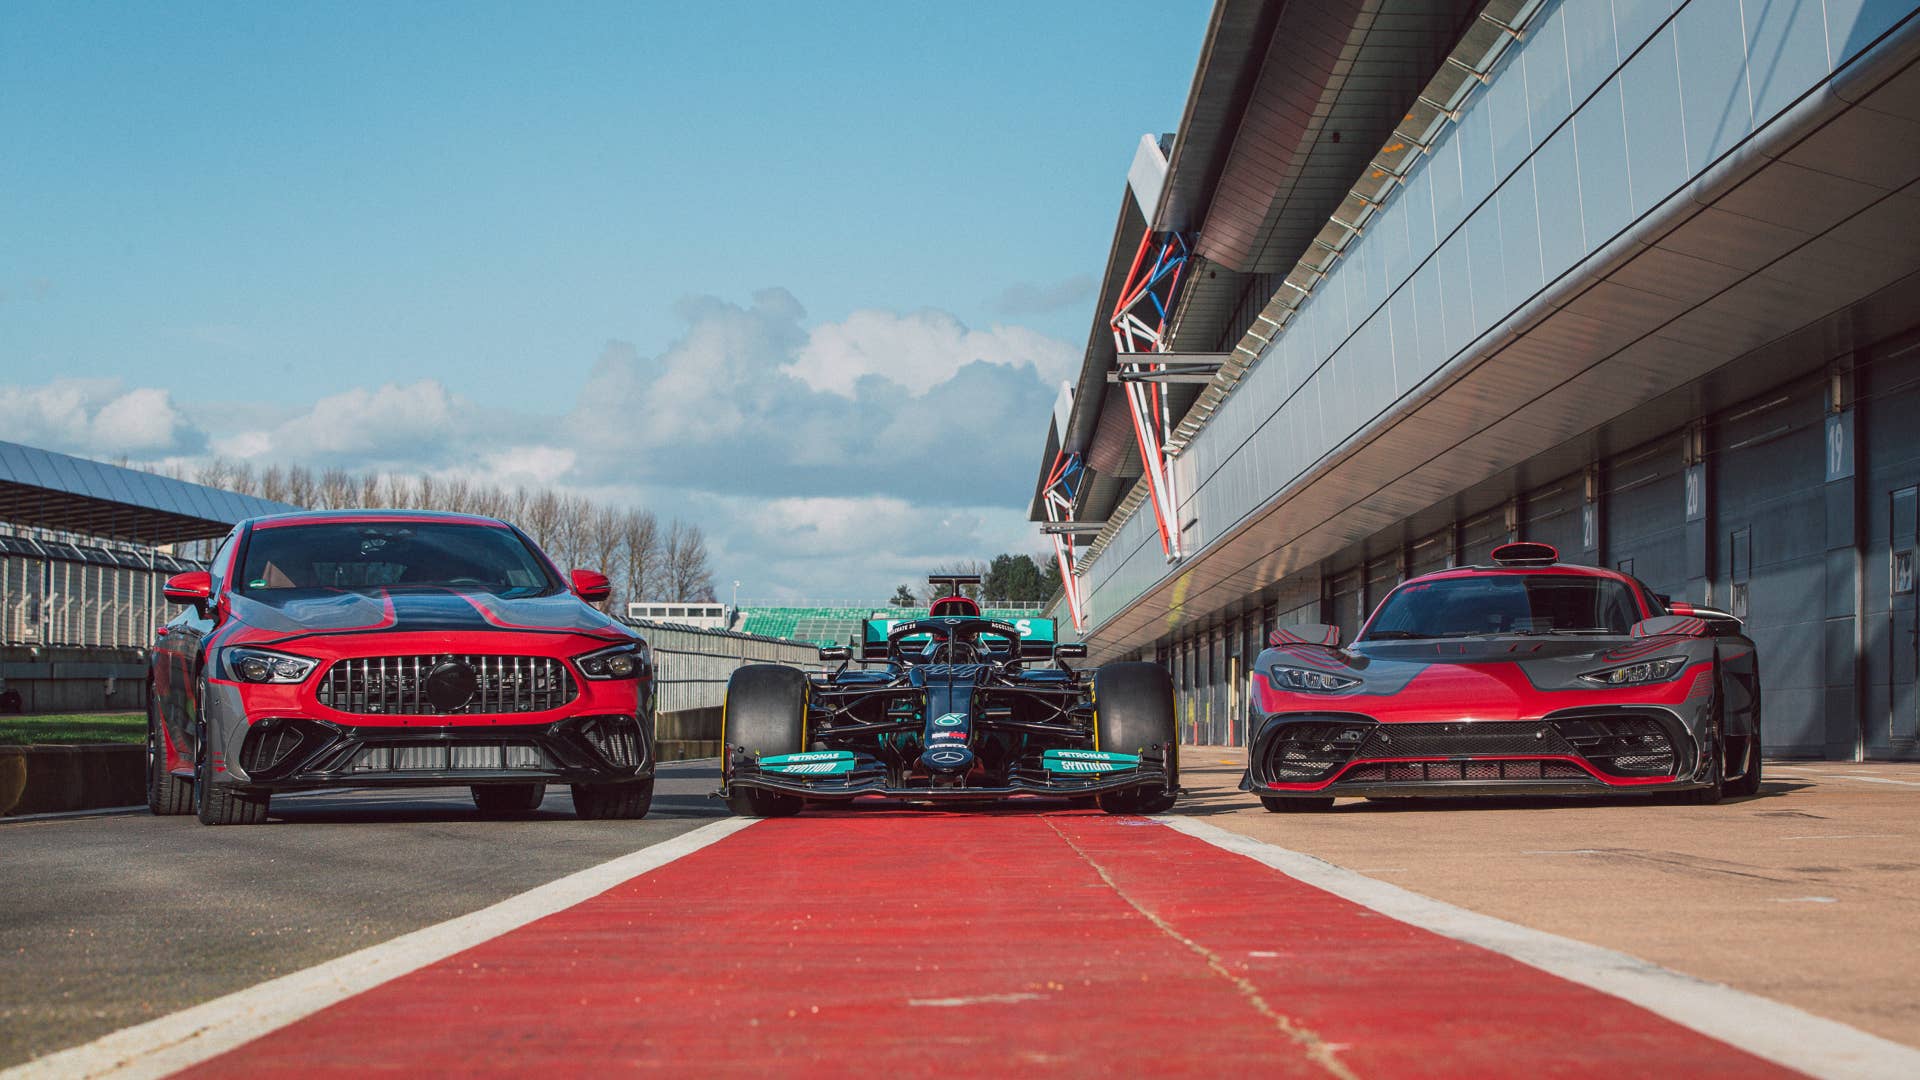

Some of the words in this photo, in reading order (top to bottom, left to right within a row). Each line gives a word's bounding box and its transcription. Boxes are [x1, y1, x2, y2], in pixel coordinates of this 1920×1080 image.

[1829, 424, 1843, 473] 19
[1687, 473, 1698, 515] 20
[1584, 510, 1593, 547] 21
[787, 753, 839, 761] PETRONAS
[1057, 751, 1110, 760] PETRONAS
